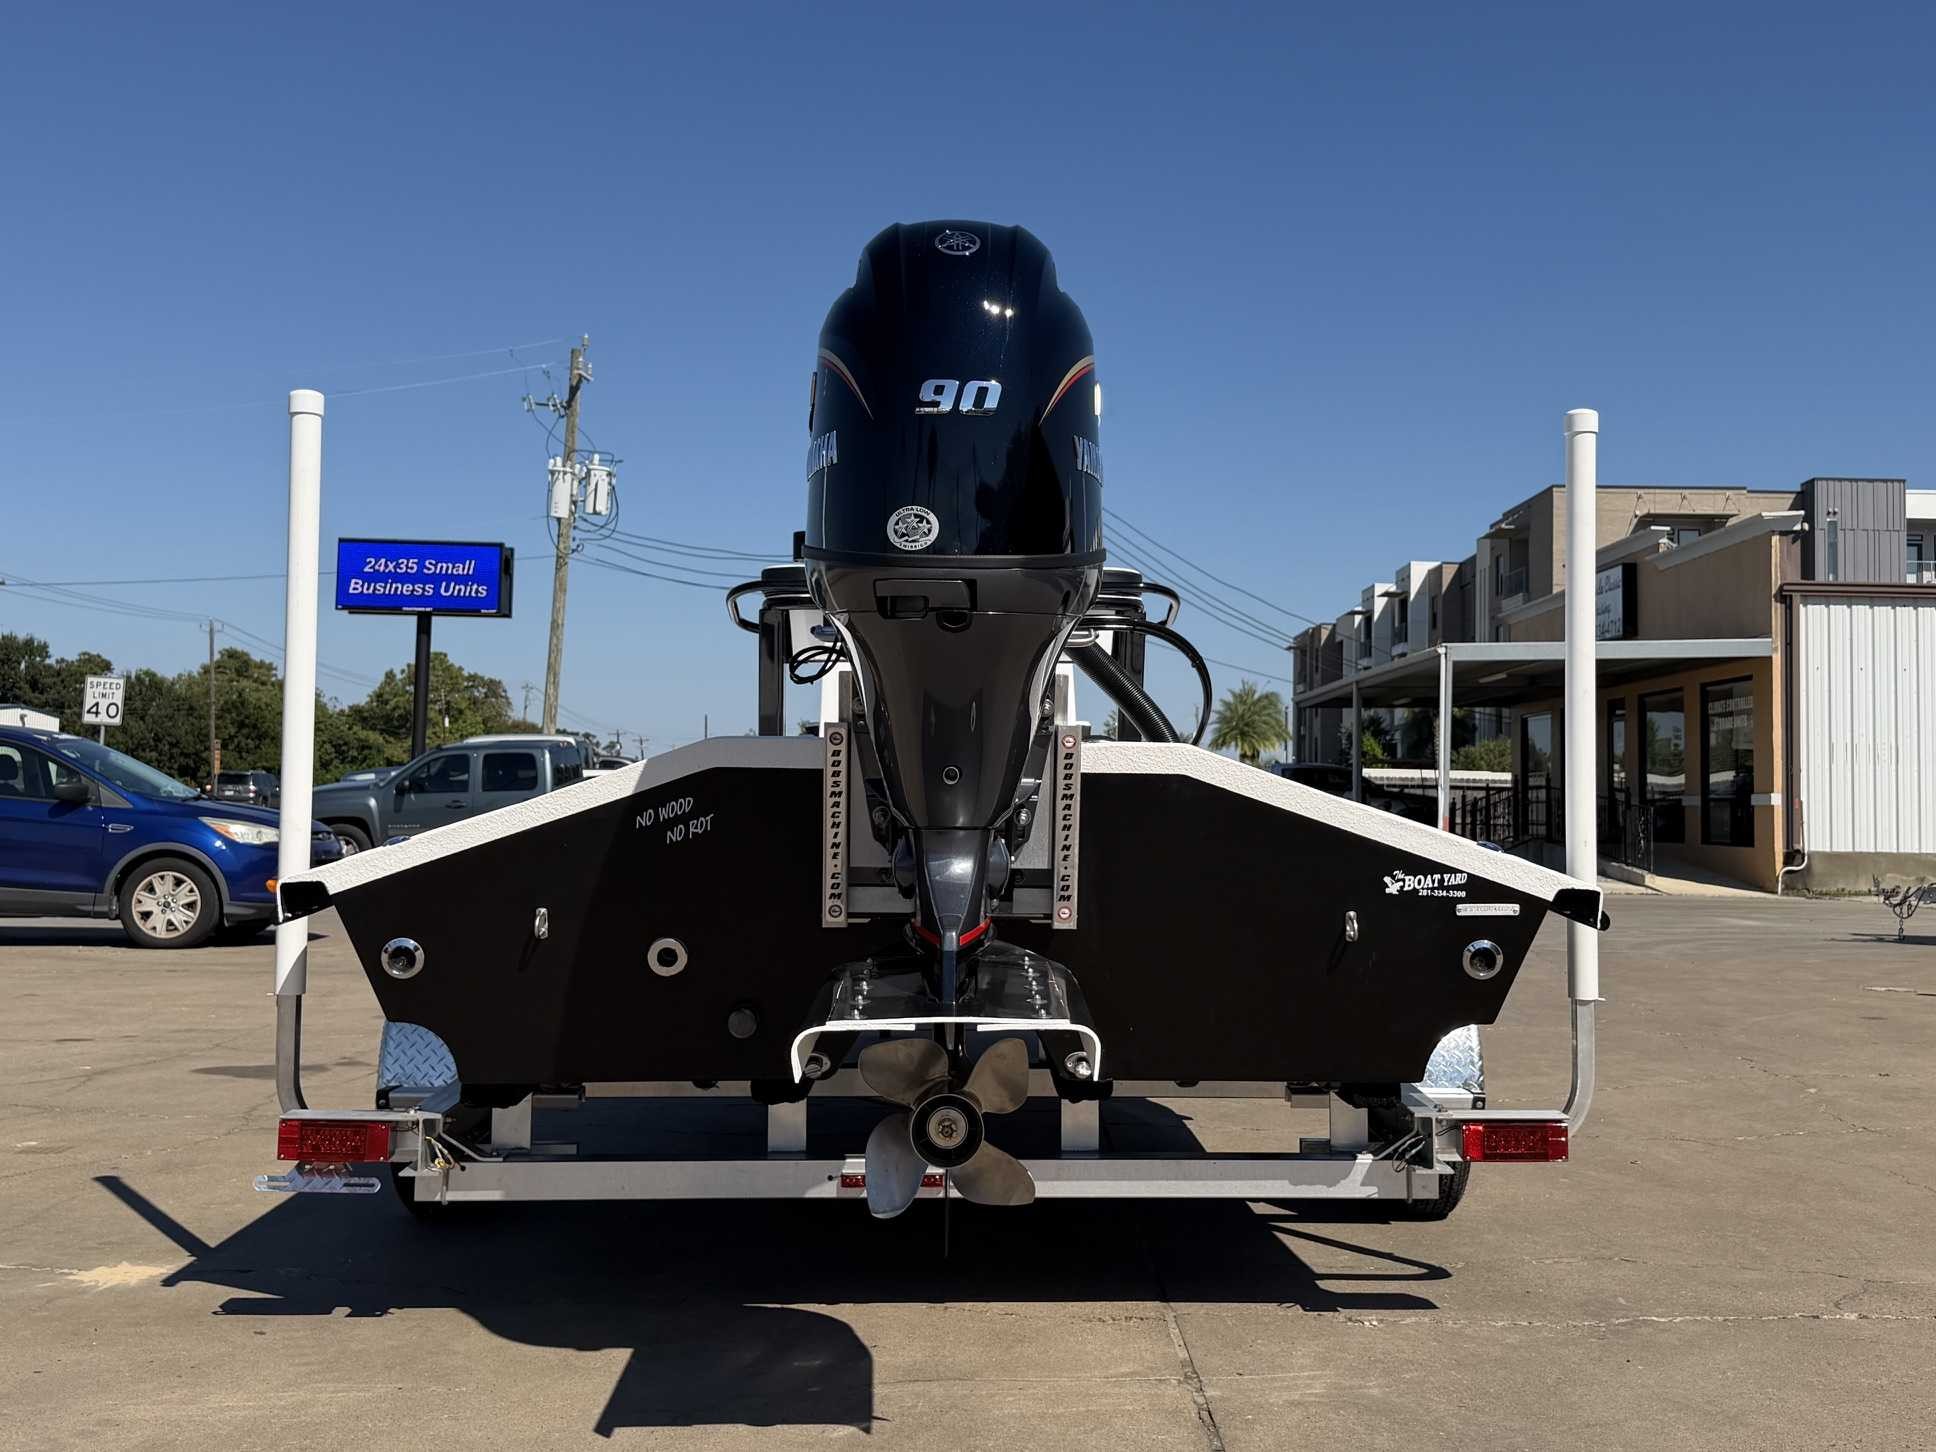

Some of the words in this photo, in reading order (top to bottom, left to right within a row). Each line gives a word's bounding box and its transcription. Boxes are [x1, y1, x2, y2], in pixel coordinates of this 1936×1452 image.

[914, 379, 1002, 416] 90
[363, 557, 418, 574] 24x35
[423, 559, 475, 576] Small
[348, 578, 434, 596] Business
[440, 581, 488, 598] Units
[89, 680, 121, 690] SPEED
[92, 691, 115, 700] LIMIT
[86, 701, 119, 719] 40
[636, 809, 654, 829] NO
[659, 797, 694, 822] WOOD
[666, 824, 685, 844] NO
[689, 813, 714, 839] ROT
[1403, 874, 1441, 891] BOAT
[1443, 873, 1468, 886] YARD
